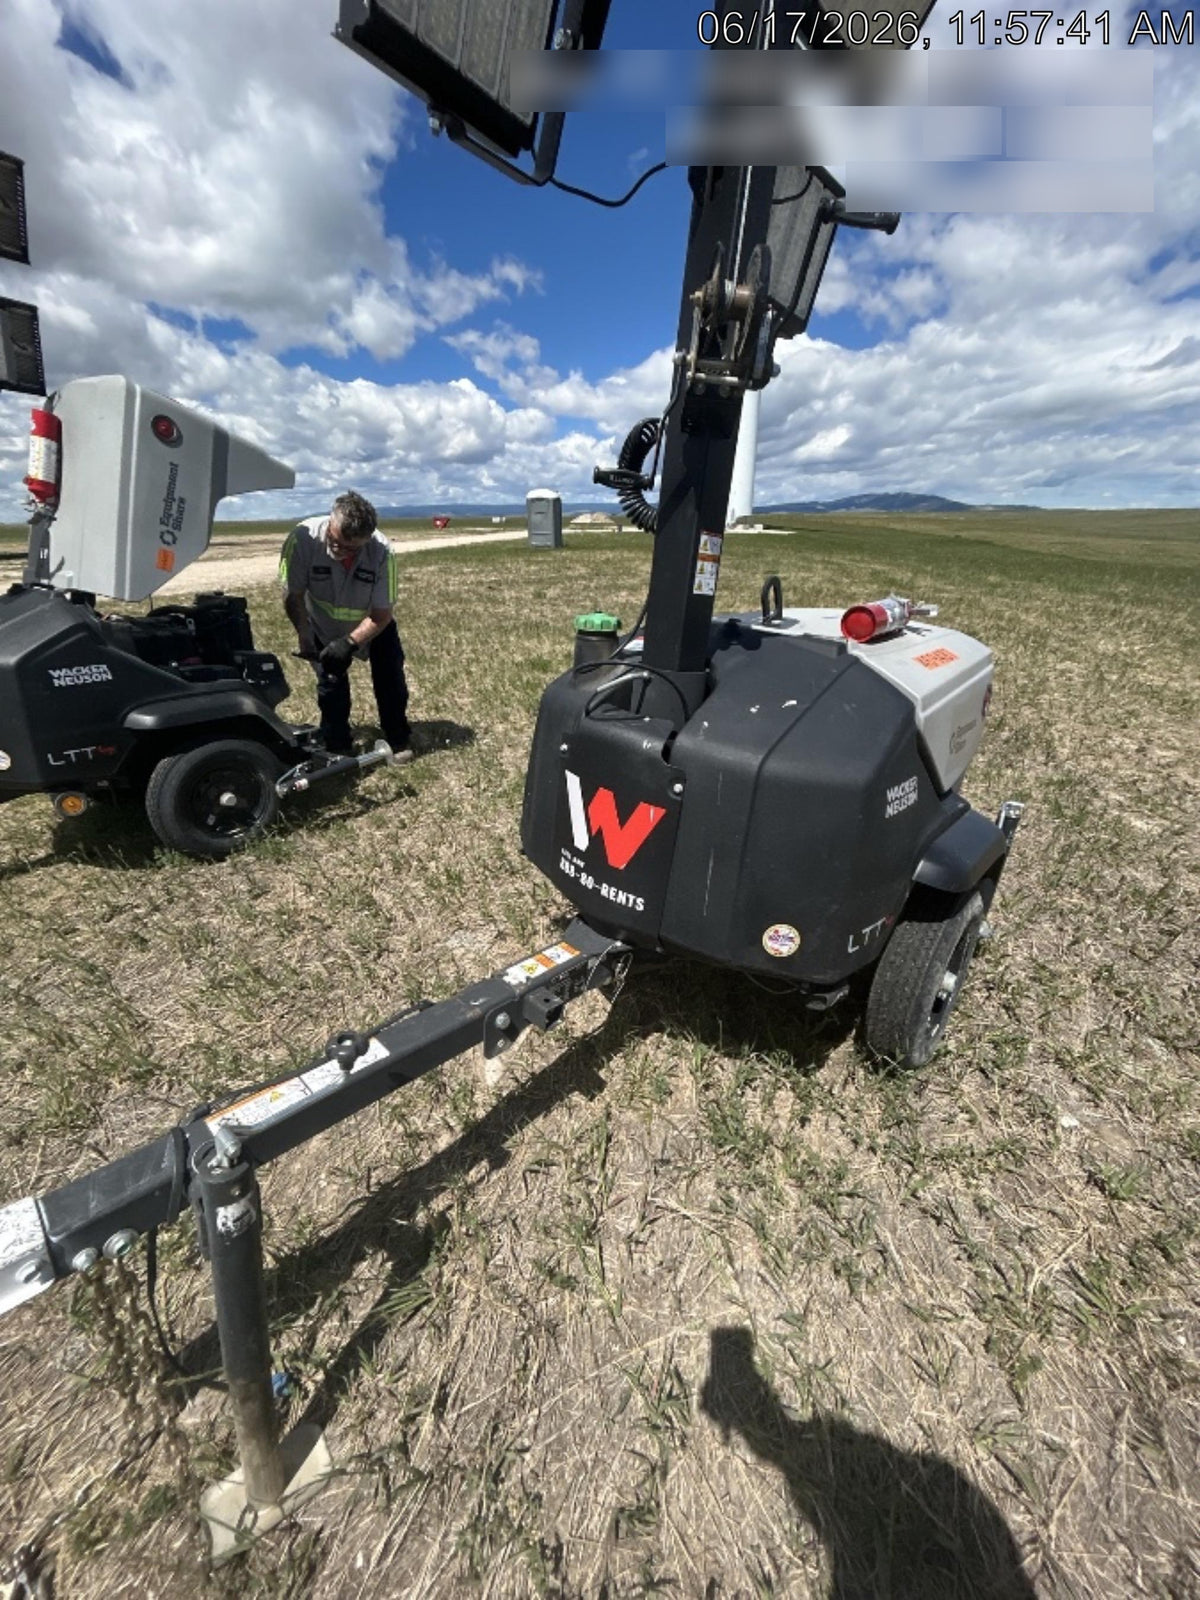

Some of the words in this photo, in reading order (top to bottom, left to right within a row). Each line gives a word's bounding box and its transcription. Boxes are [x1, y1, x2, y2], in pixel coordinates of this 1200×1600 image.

[160, 461, 179, 527] Equipment
[172, 496, 187, 532] Share
[48, 664, 108, 678] WACKER
[53, 673, 113, 687] NEUSON
[886, 776, 918, 803] WACKER
[885, 789, 918, 819] NEUSON
